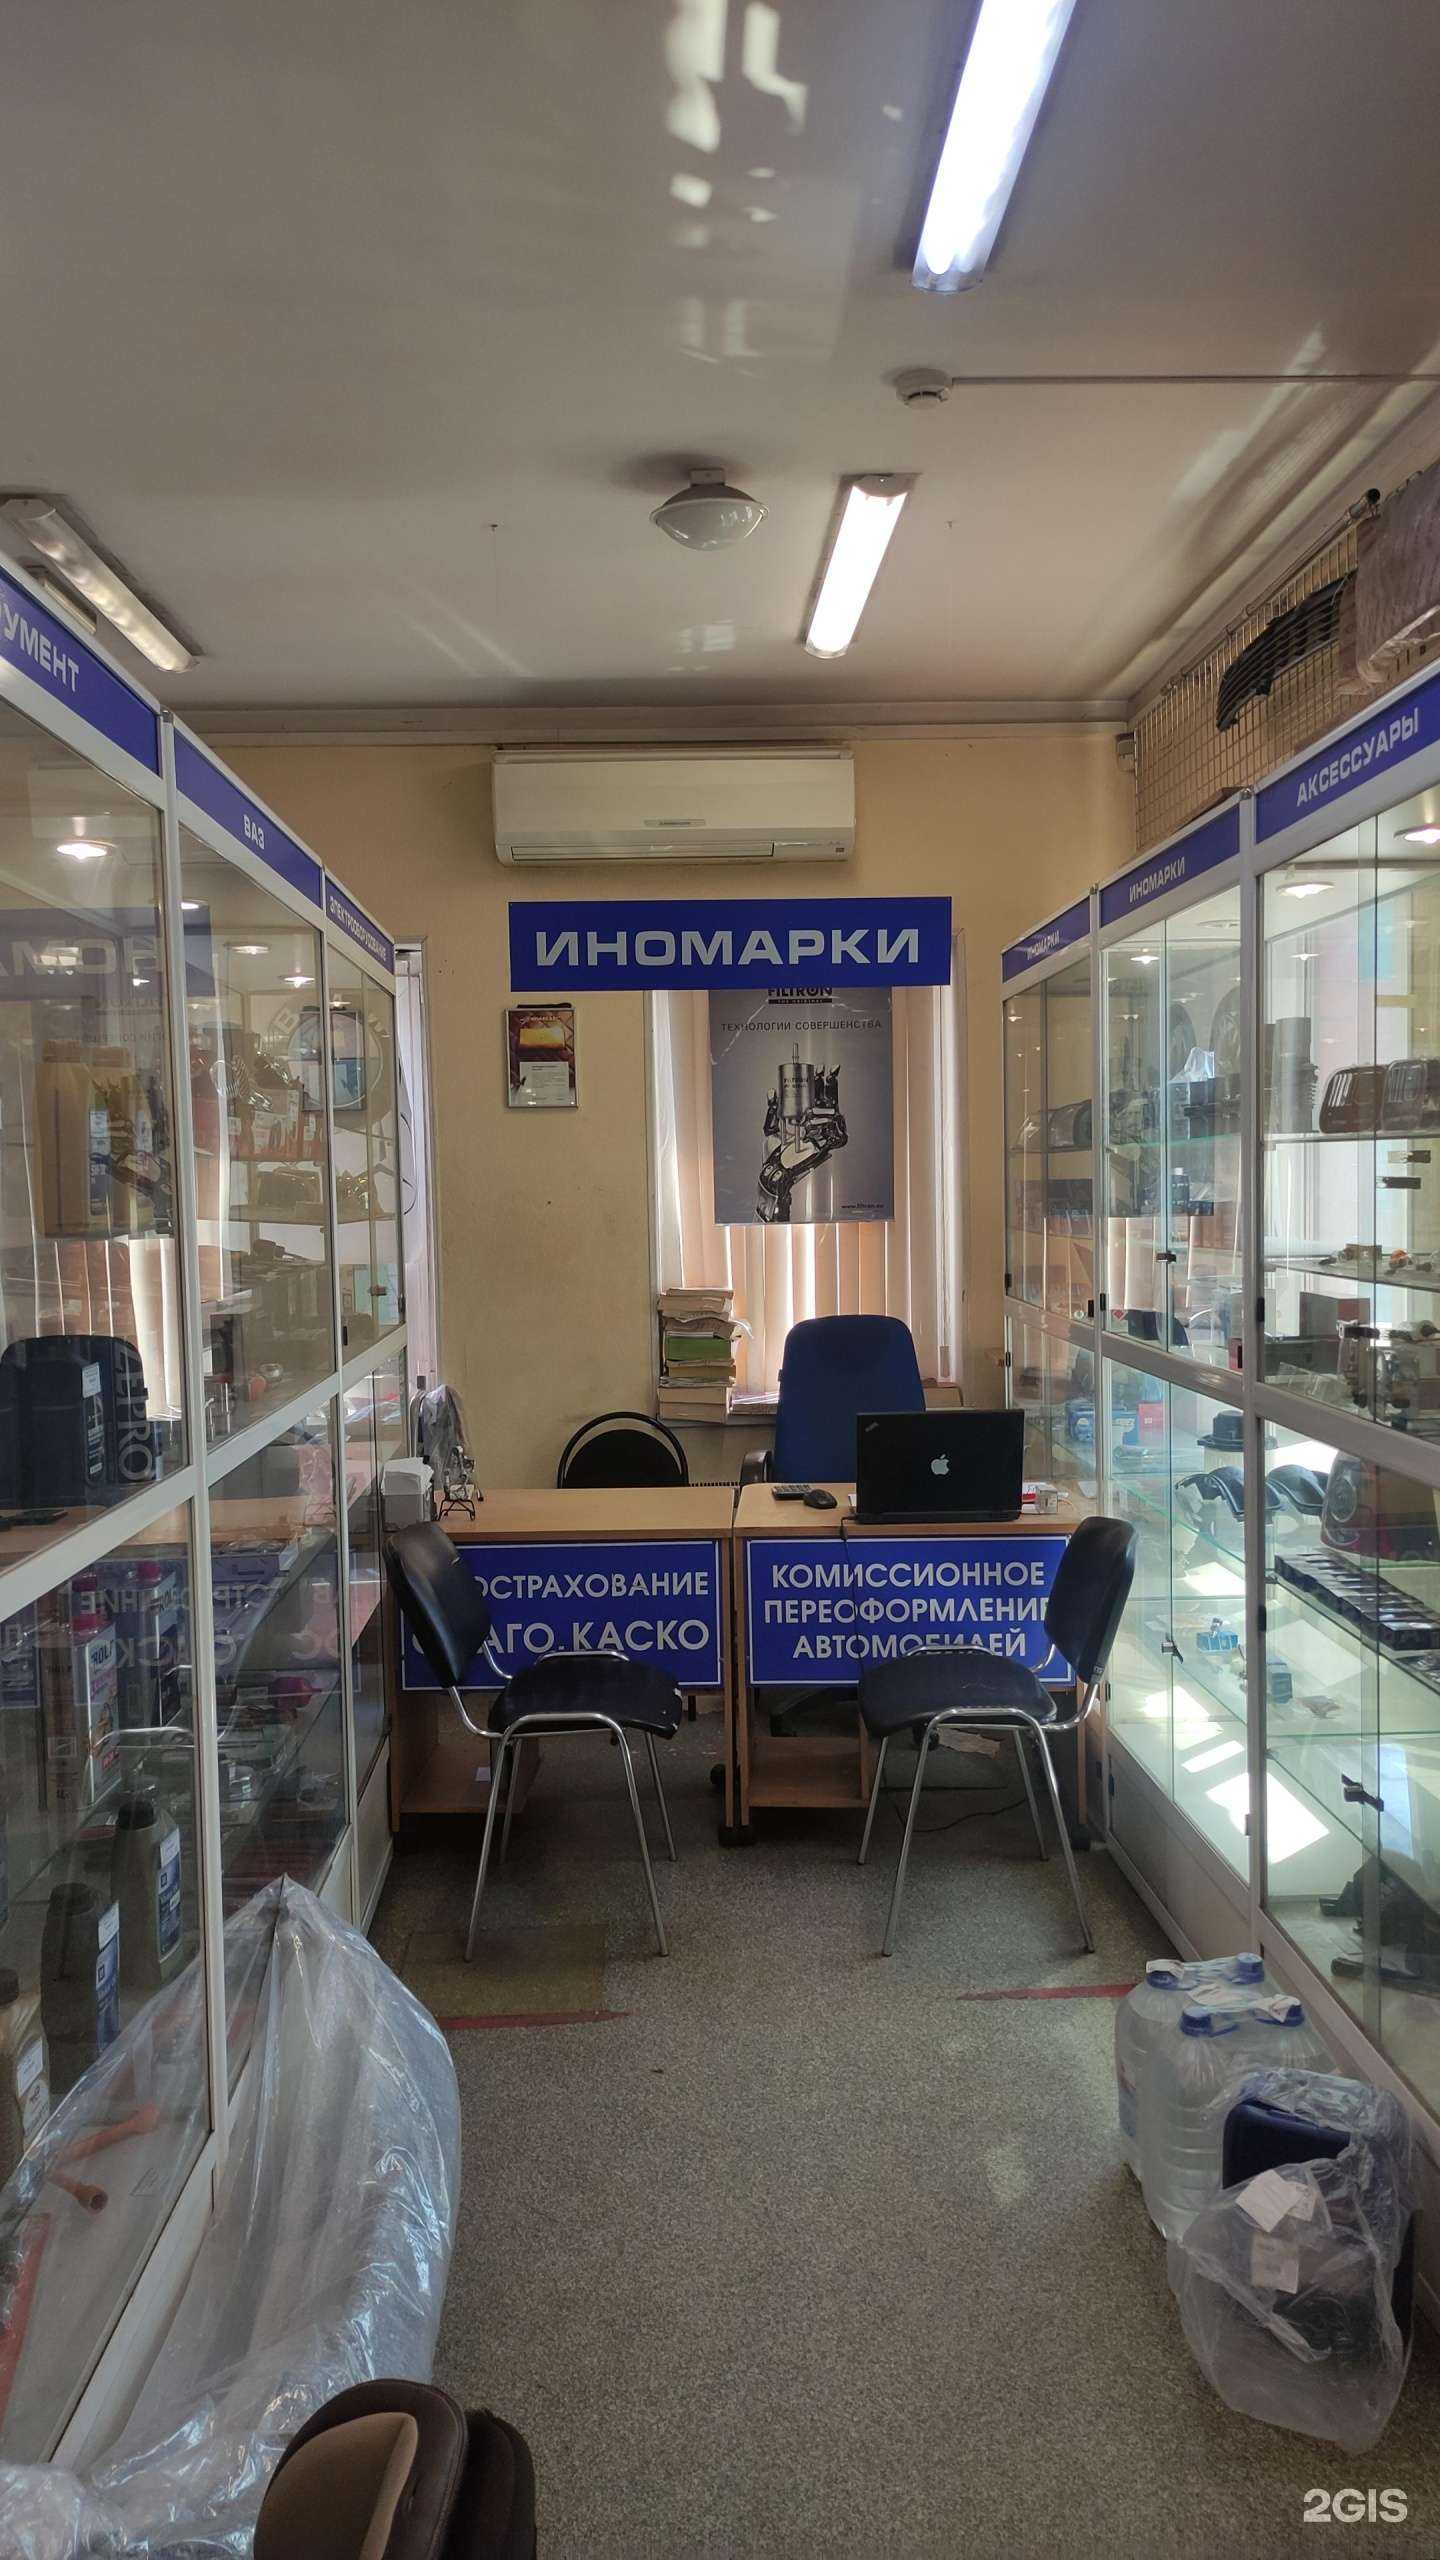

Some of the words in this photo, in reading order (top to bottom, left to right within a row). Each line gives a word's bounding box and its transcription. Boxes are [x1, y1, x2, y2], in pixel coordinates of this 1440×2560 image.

[0, 602, 80, 693] УМЕНТ
[1296, 707, 1419, 807] АКСЕССУАРЫ
[243, 814, 265, 850] ВАЗ
[1129, 856, 1185, 904] ИНОМАРКИ
[535, 928, 919, 967] ИНОМАРКИ
[768, 986, 833, 997] FILTRON
[721, 1022, 791, 1032] ТЕХНОЛОГИИ
[795, 1019, 882, 1031] СОВЕРШЕНСТВА
[772, 1561, 1045, 1588] КОМИССИОННОЕ
[573, 1619, 709, 1652] КАСКО
[792, 1627, 1026, 1659] АВТОМОБИЛЕЙ
